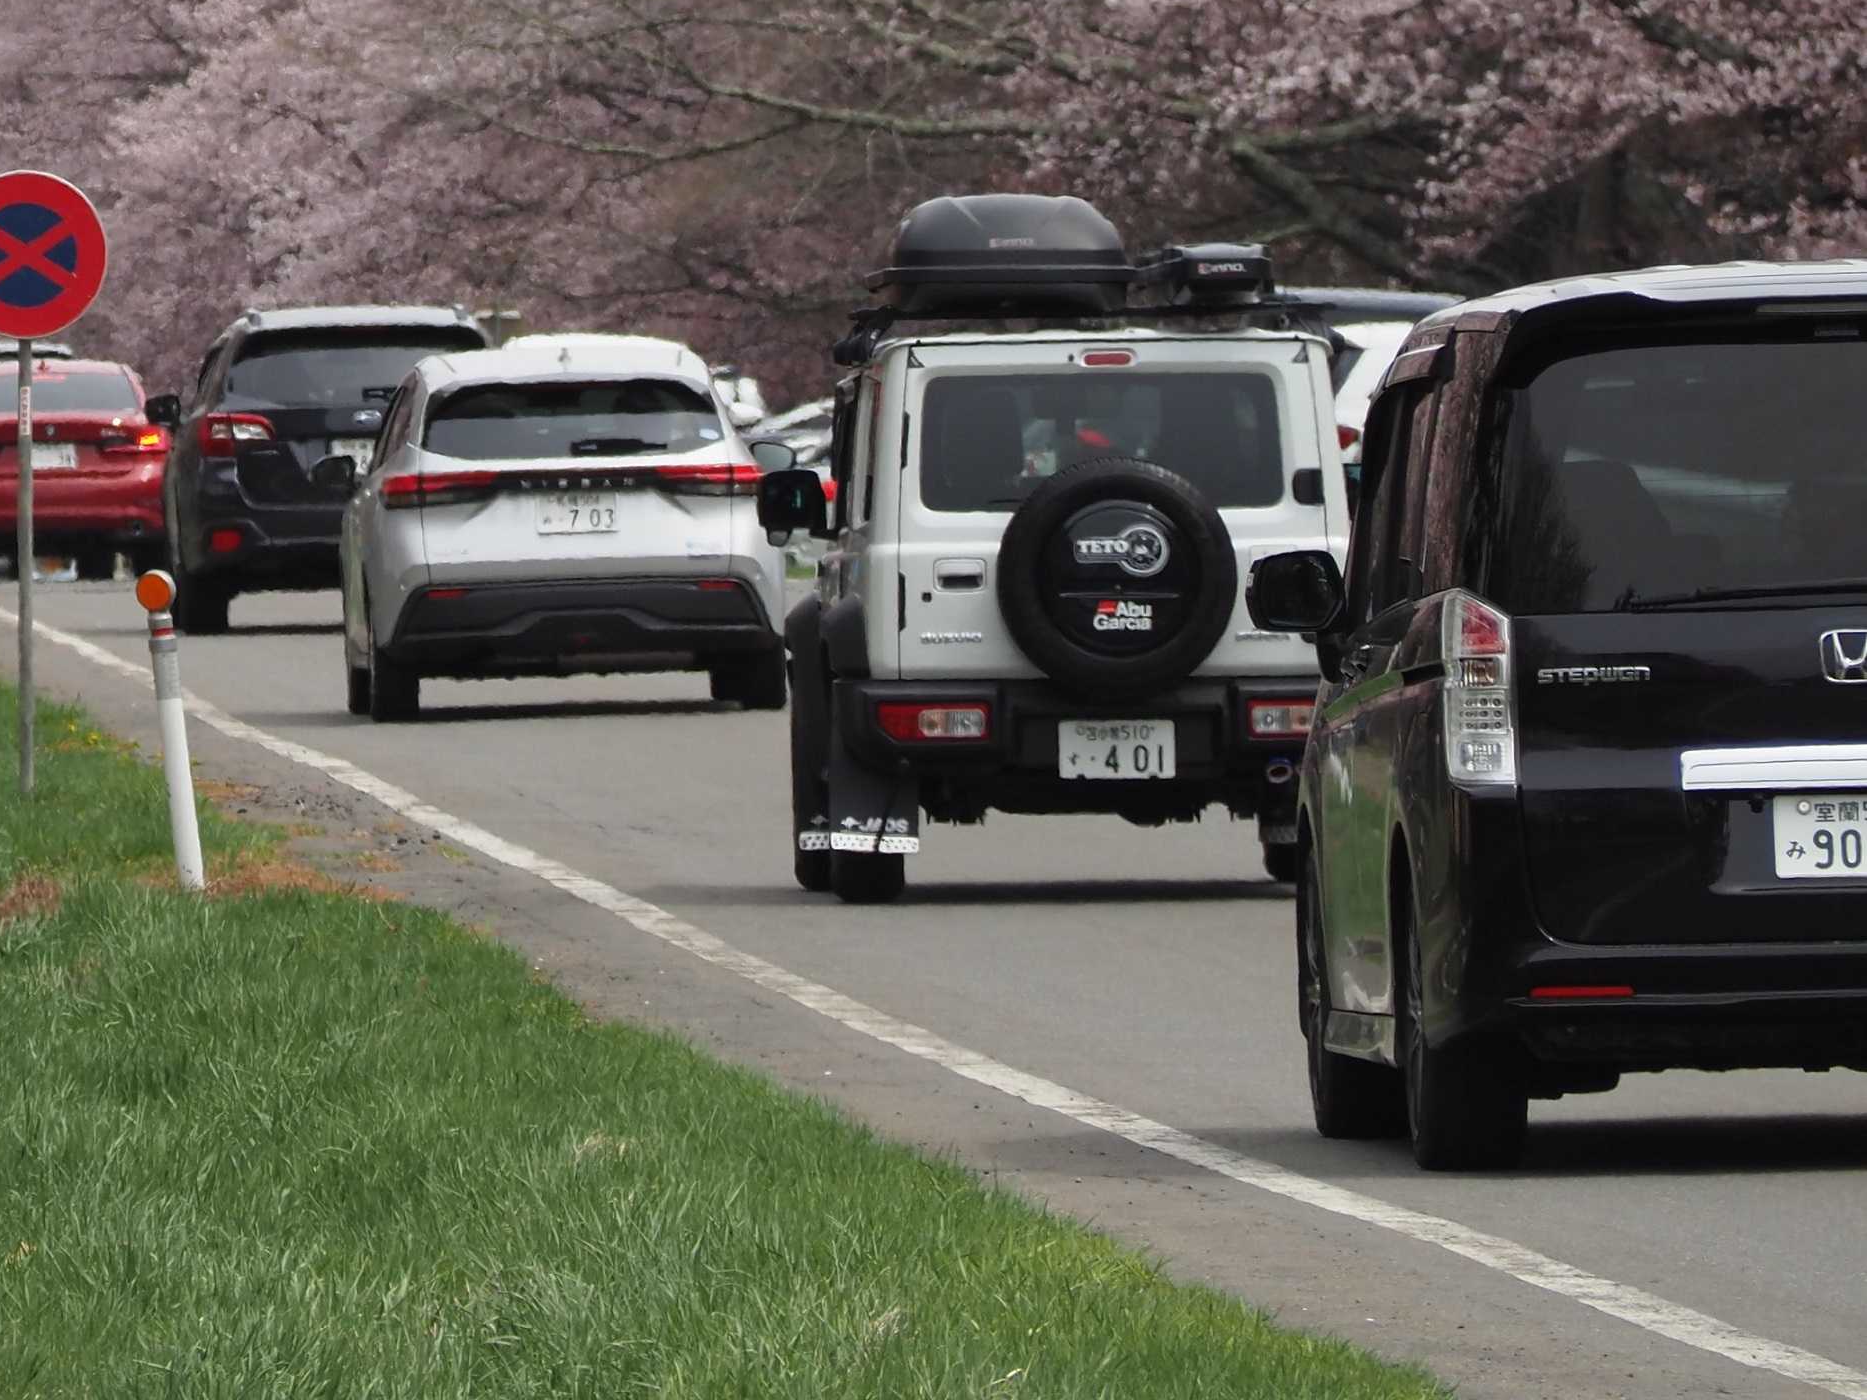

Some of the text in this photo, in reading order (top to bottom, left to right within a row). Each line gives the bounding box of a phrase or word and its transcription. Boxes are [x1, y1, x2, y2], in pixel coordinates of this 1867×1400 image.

[1076, 539, 1129, 553] TETO
[1116, 600, 1152, 617] Abu
[1093, 614, 1152, 631] Garcia
[1786, 840, 1806, 860] み
